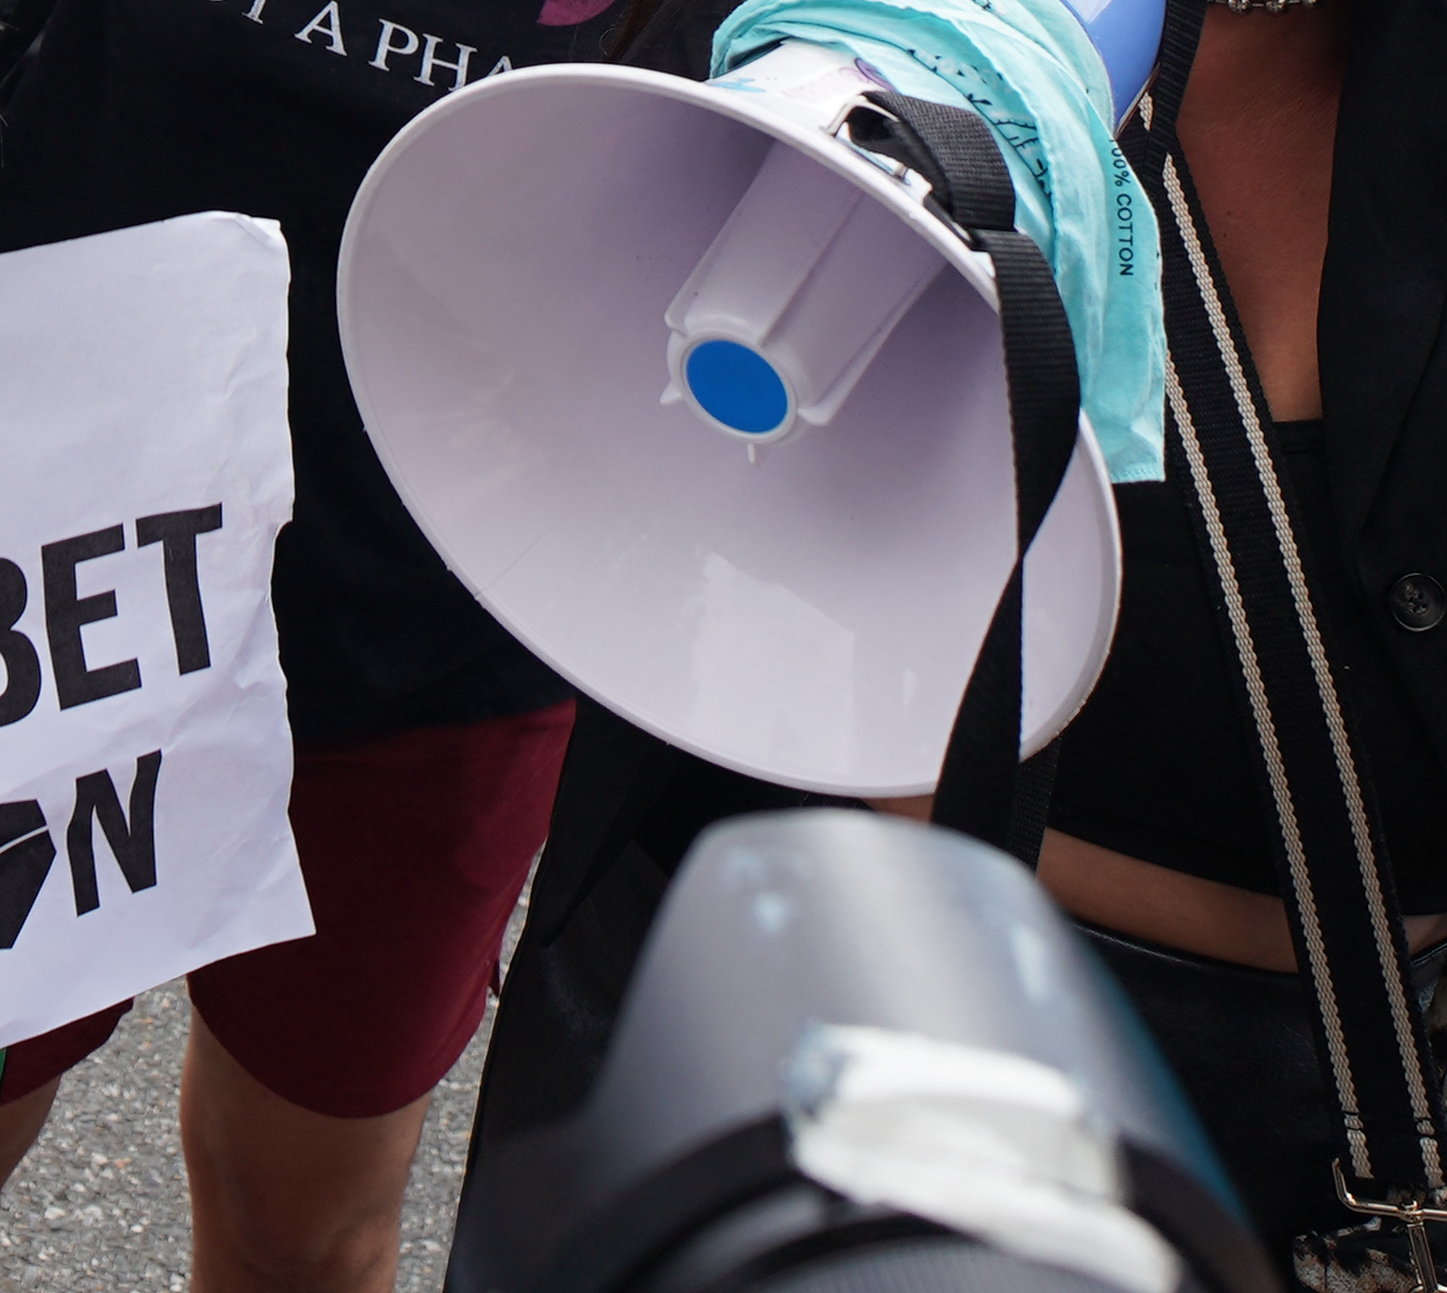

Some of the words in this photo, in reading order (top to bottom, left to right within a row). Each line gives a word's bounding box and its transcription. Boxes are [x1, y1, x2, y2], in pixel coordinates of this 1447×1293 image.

[294, 0, 348, 57] A
[1109, 139, 1131, 187] 00%
[1116, 193, 1134, 276] COTTON
